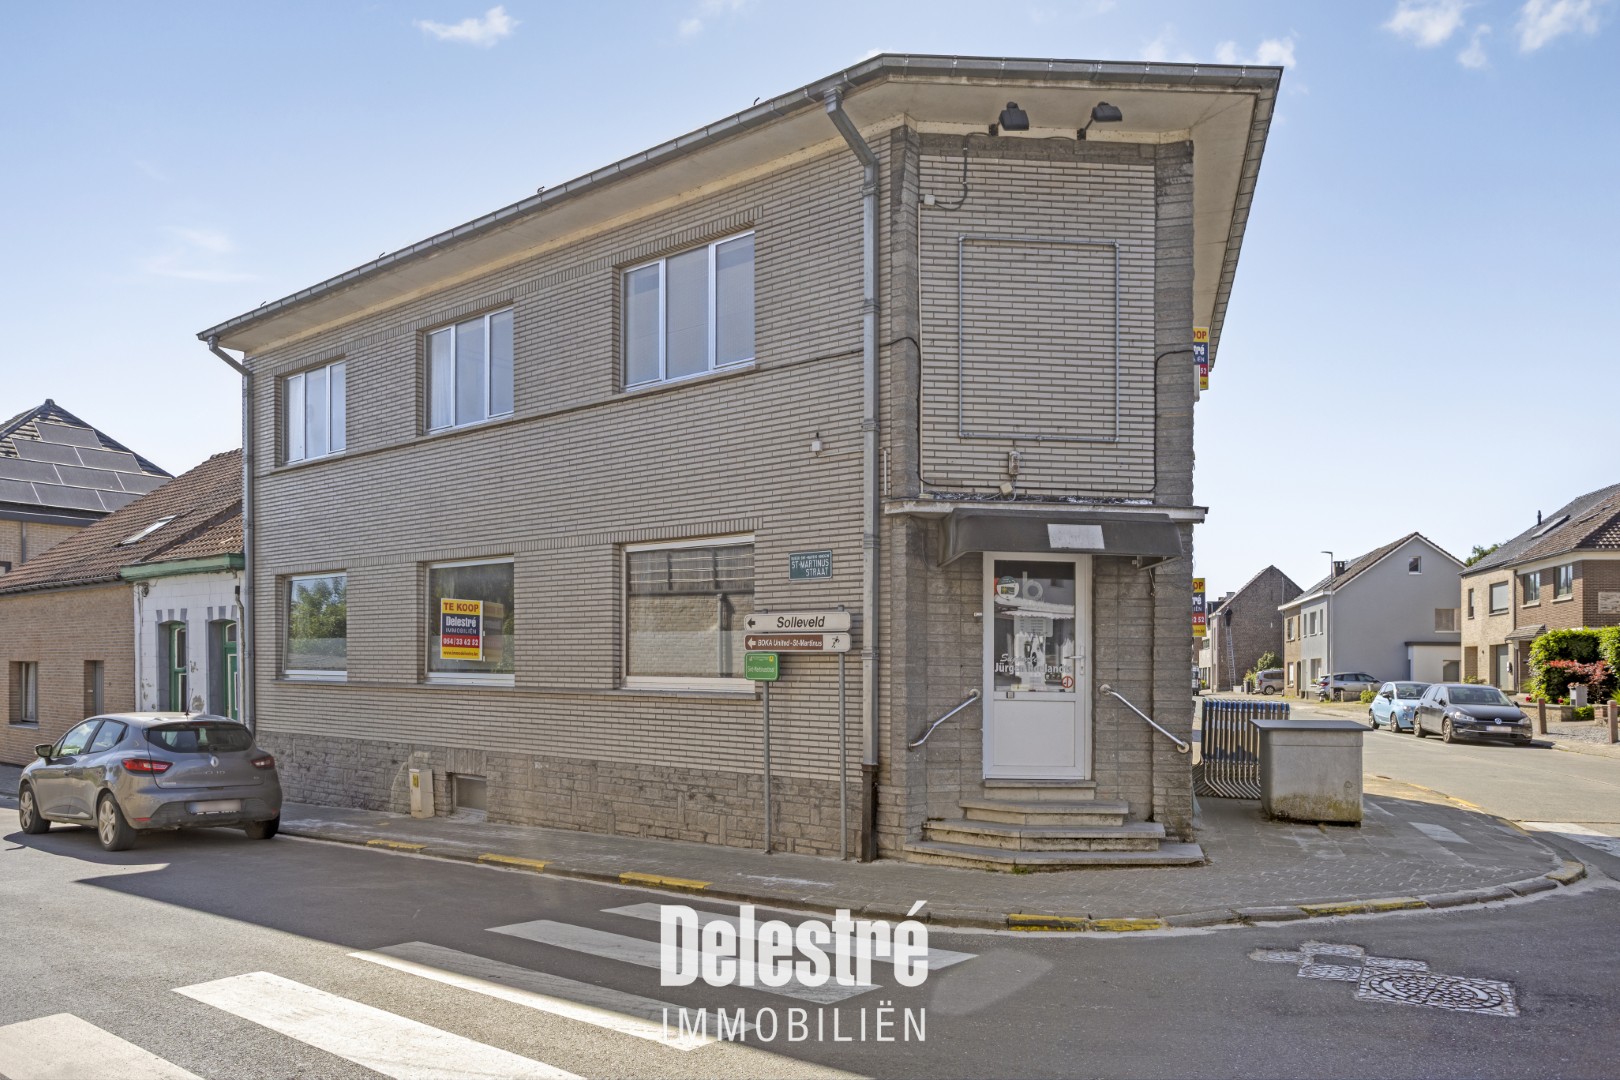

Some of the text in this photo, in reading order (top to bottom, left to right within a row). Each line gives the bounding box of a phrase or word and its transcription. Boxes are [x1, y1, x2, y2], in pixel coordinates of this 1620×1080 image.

[805, 567, 829, 577] STRAAT
[443, 602, 479, 612] TE KOOP
[445, 615, 477, 628] Delestré
[776, 615, 826, 628] Solleveld
[445, 627, 477, 635] IMMOBILIËN
